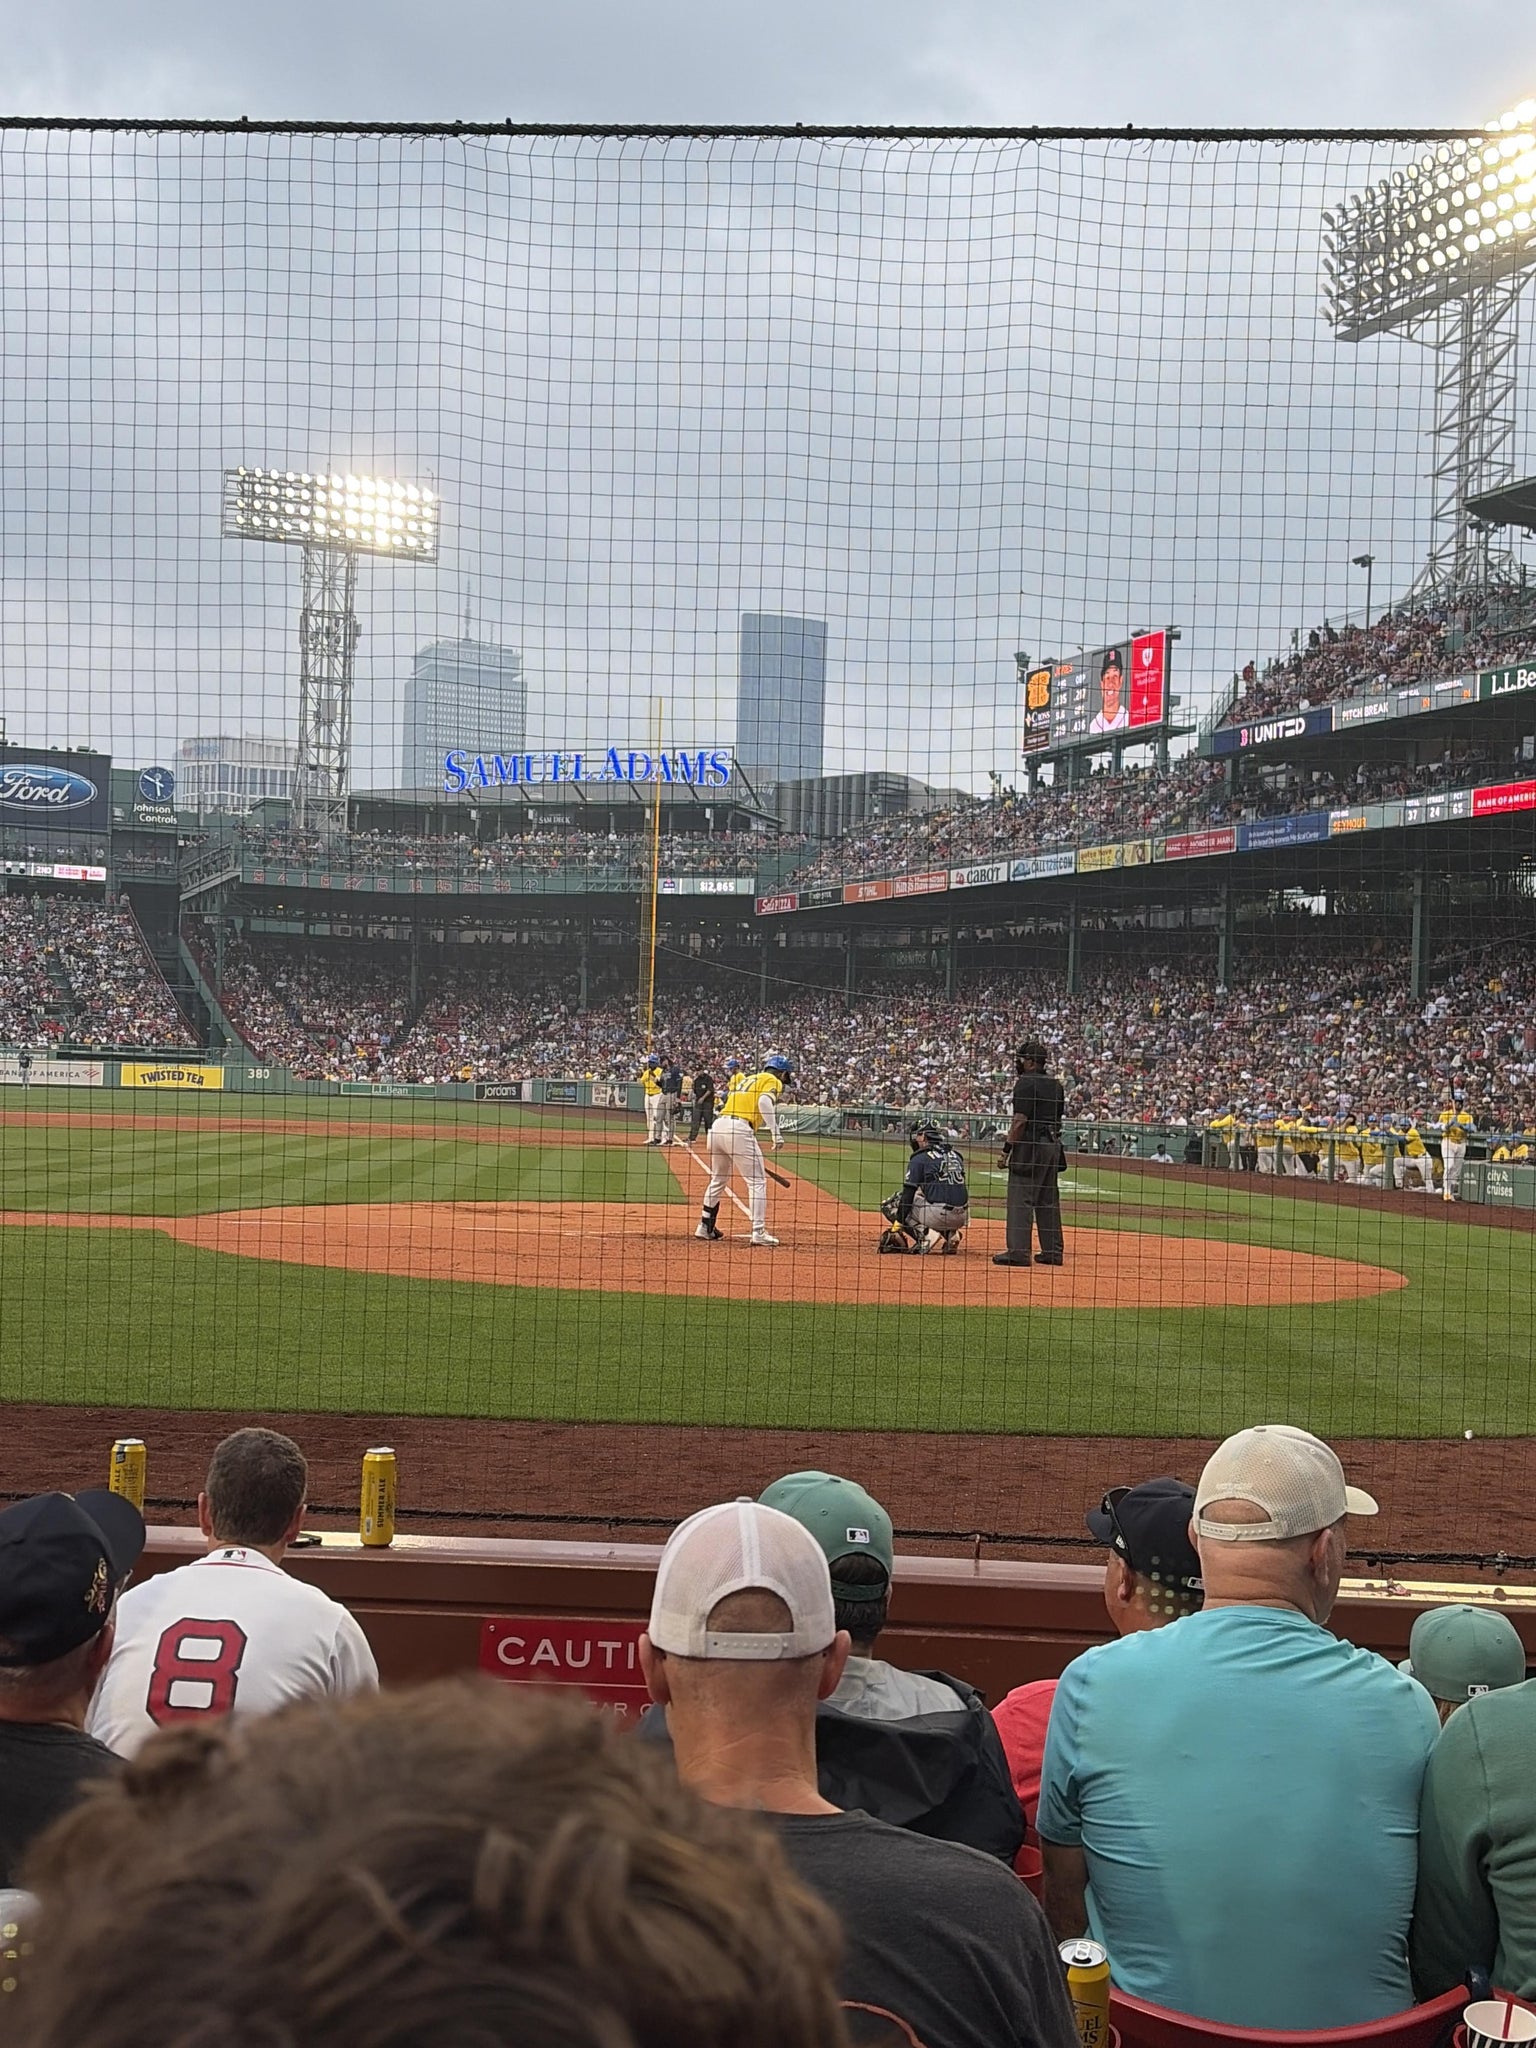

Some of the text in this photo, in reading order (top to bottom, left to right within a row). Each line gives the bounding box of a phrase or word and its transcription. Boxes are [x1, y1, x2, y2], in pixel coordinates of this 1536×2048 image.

[1342, 702, 1389, 722] PITCH BREAK
[1255, 718, 1306, 744] UNITED
[443, 745, 730, 793] SAMUEL ADAMS
[0, 770, 72, 803] Ford
[134, 803, 171, 815] Johnson
[1477, 798, 1497, 808] BANK
[1497, 796, 1508, 805] OF
[139, 813, 178, 825] Controls
[1407, 810, 1418, 821] 37
[1430, 807, 1440, 818] 24
[1333, 817, 1367, 832] SEYMOUR
[699, 881, 735, 893] $12,865
[40, 1070, 80, 1078] AMERICA
[140, 1070, 205, 1087] TWISTED TEA
[247, 1068, 270, 1080] 380
[1487, 1169, 1502, 1182] city
[1486, 1182, 1513, 1197] cruises
[376, 1478, 386, 1528] SUMMER ALE
[496, 1636, 636, 1670] CAUTI
[146, 1617, 248, 1730] 8
